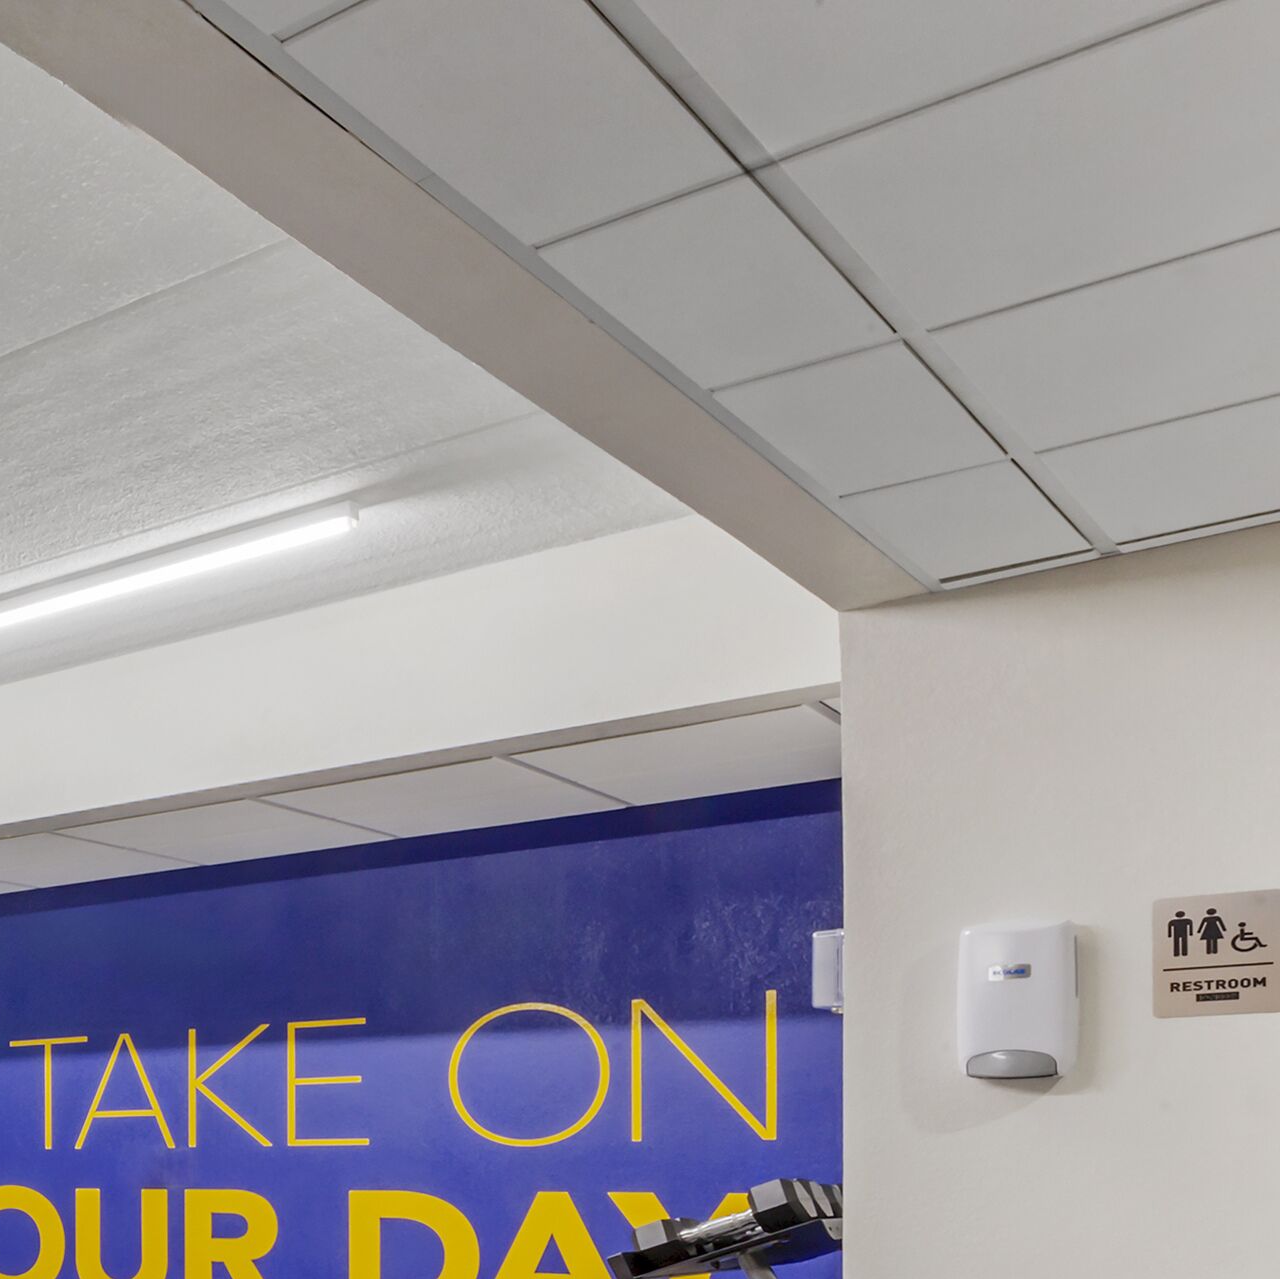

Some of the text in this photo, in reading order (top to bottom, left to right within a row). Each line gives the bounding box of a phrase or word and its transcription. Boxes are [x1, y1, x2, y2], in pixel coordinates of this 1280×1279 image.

[1169, 976, 1268, 992] RESTROOM
[9, 990, 776, 1150] TAKE ON
